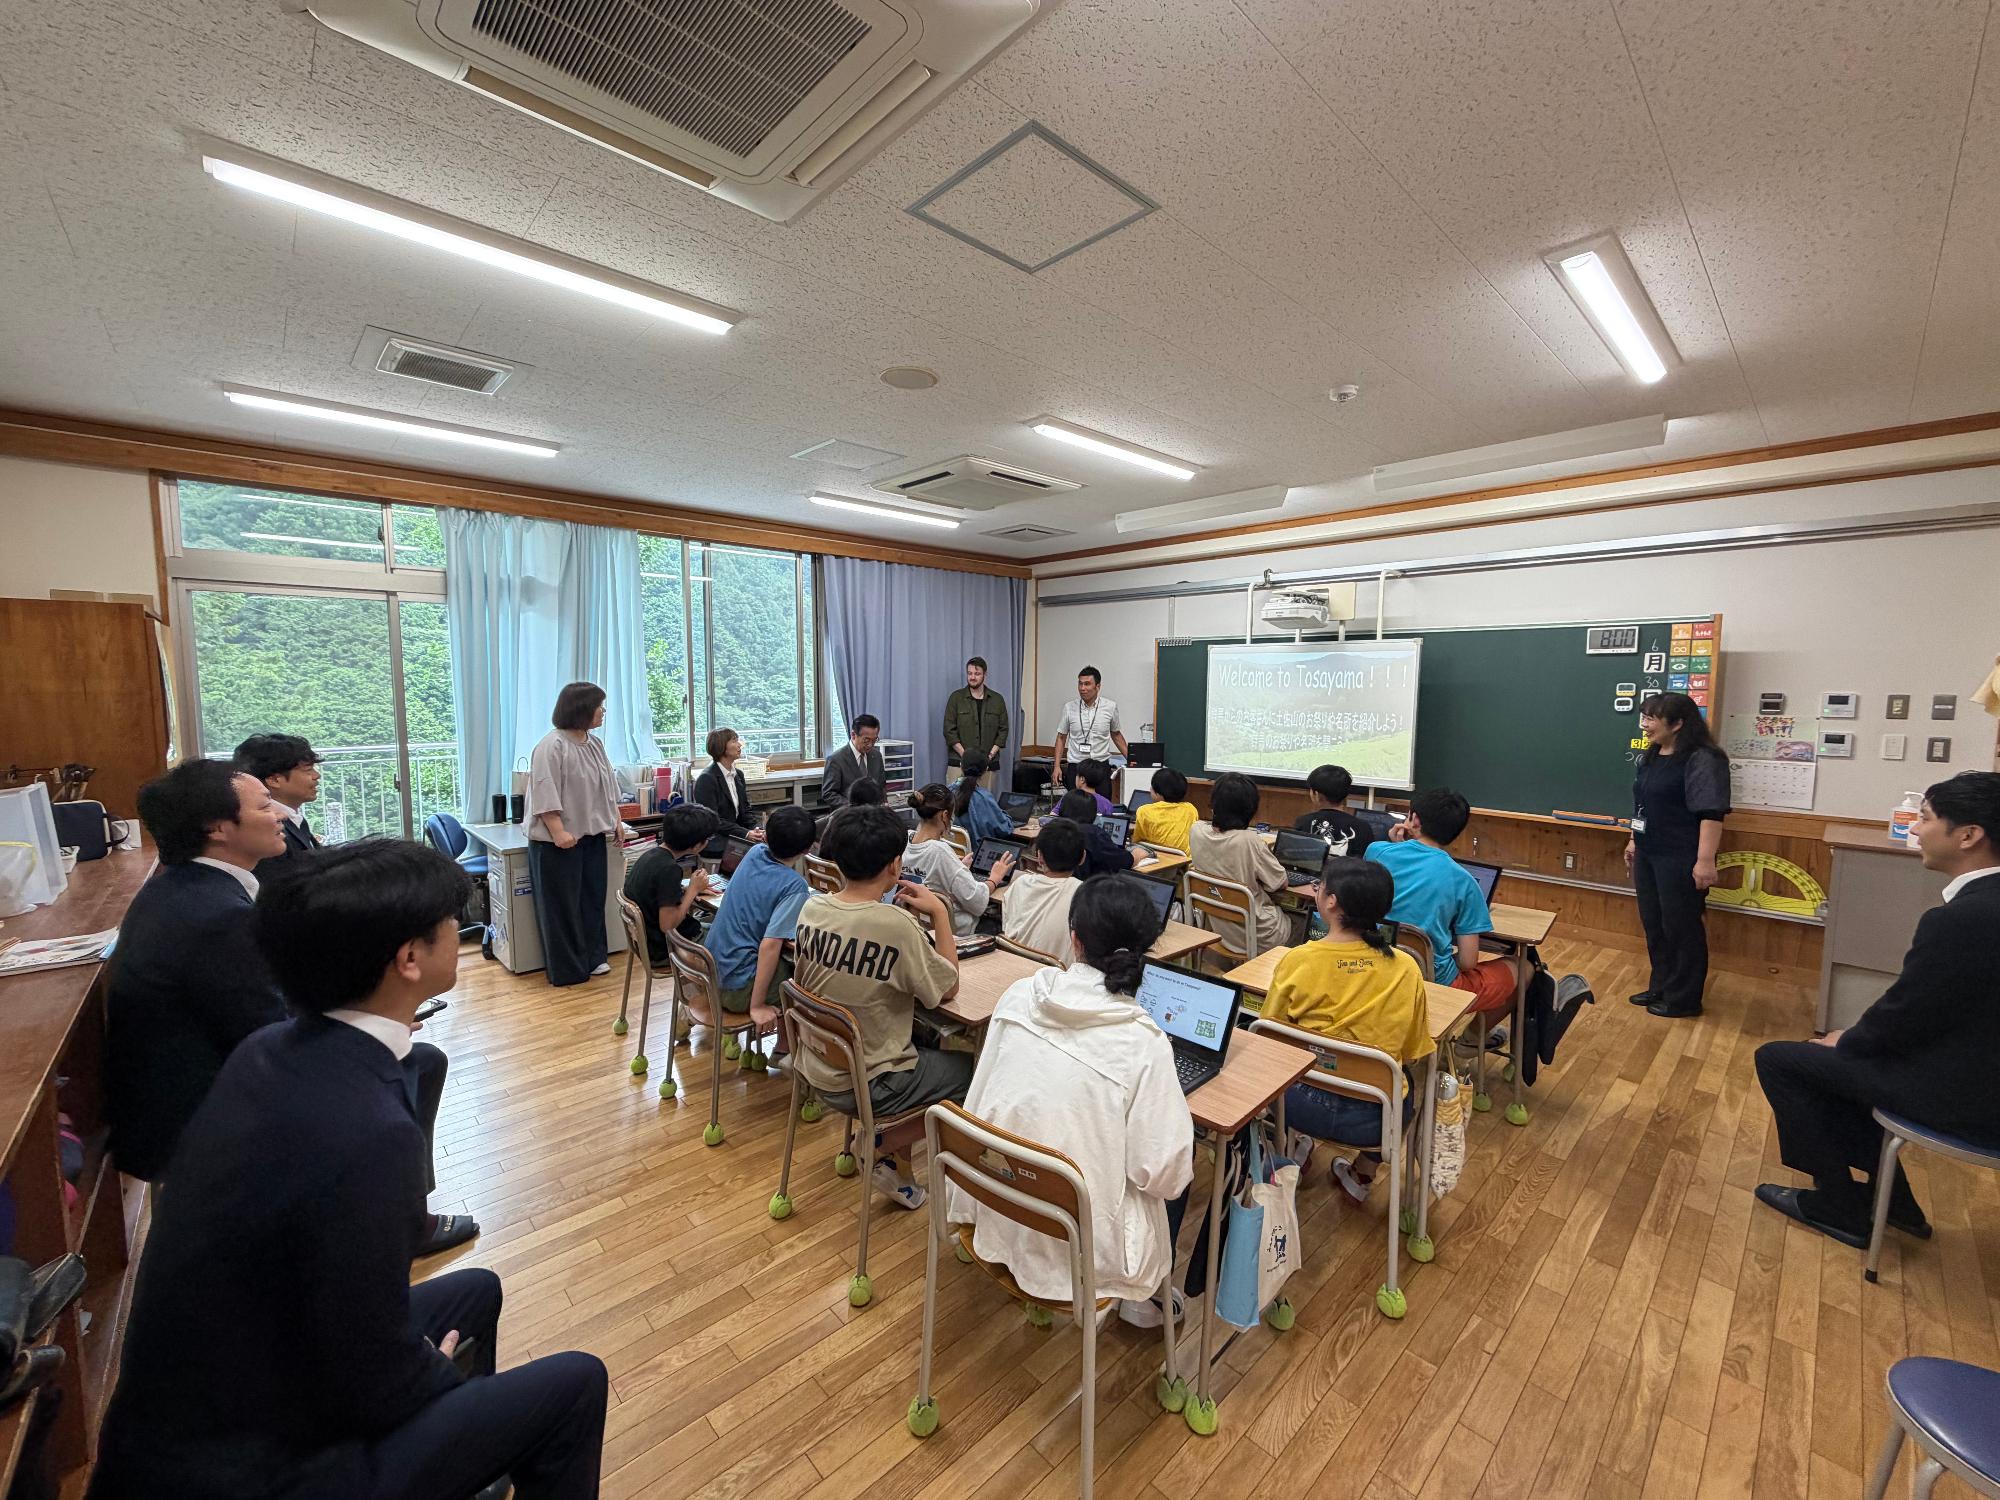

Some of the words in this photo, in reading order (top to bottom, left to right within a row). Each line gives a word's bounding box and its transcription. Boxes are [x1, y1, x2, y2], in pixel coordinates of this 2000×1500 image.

[1600, 628, 1636, 647] 8:00
[1651, 638, 1659, 652] 6
[1646, 655, 1663, 671] 月
[1218, 664, 1272, 688] Welcome
[1277, 666, 1291, 688] to
[1646, 676, 1660, 688] 30
